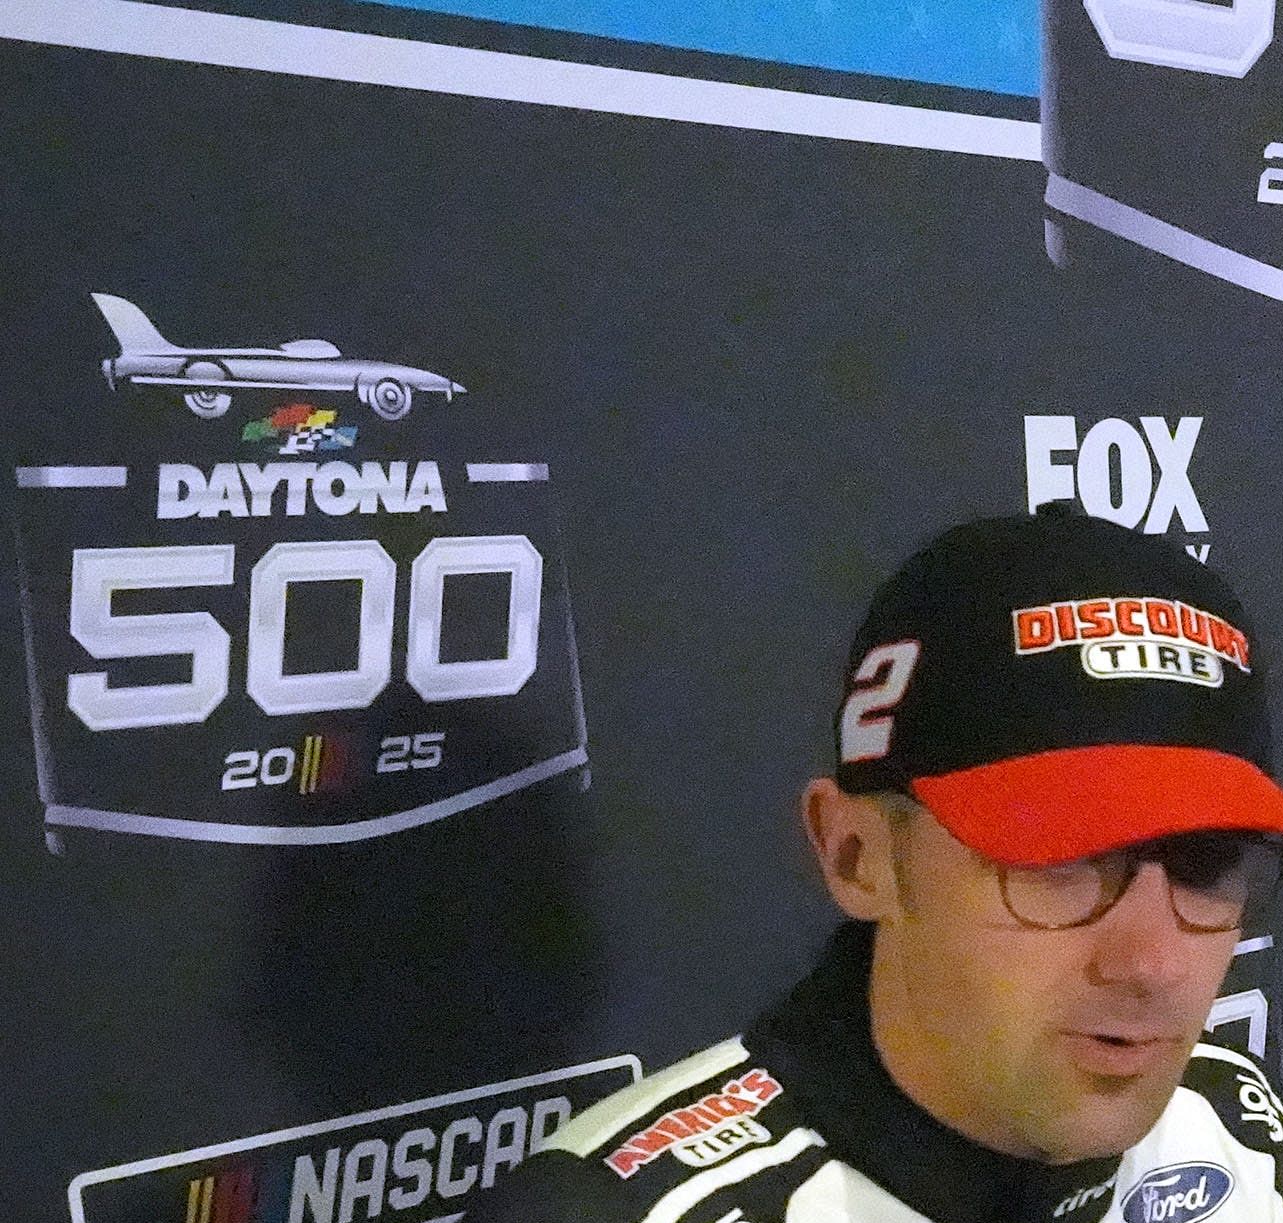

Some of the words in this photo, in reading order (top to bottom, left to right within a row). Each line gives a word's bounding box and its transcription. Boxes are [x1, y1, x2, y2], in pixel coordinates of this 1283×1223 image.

[157, 460, 449, 520] DAYTONA
[1024, 415, 1210, 535] FOX
[66, 534, 544, 732] 500
[1013, 597, 1250, 673] DISCOUNT
[1102, 643, 1212, 679] TIRE
[840, 638, 922, 765] 2
[220, 745, 296, 791] 20
[376, 731, 446, 774] 25
[683, 1119, 758, 1160] TIRE
